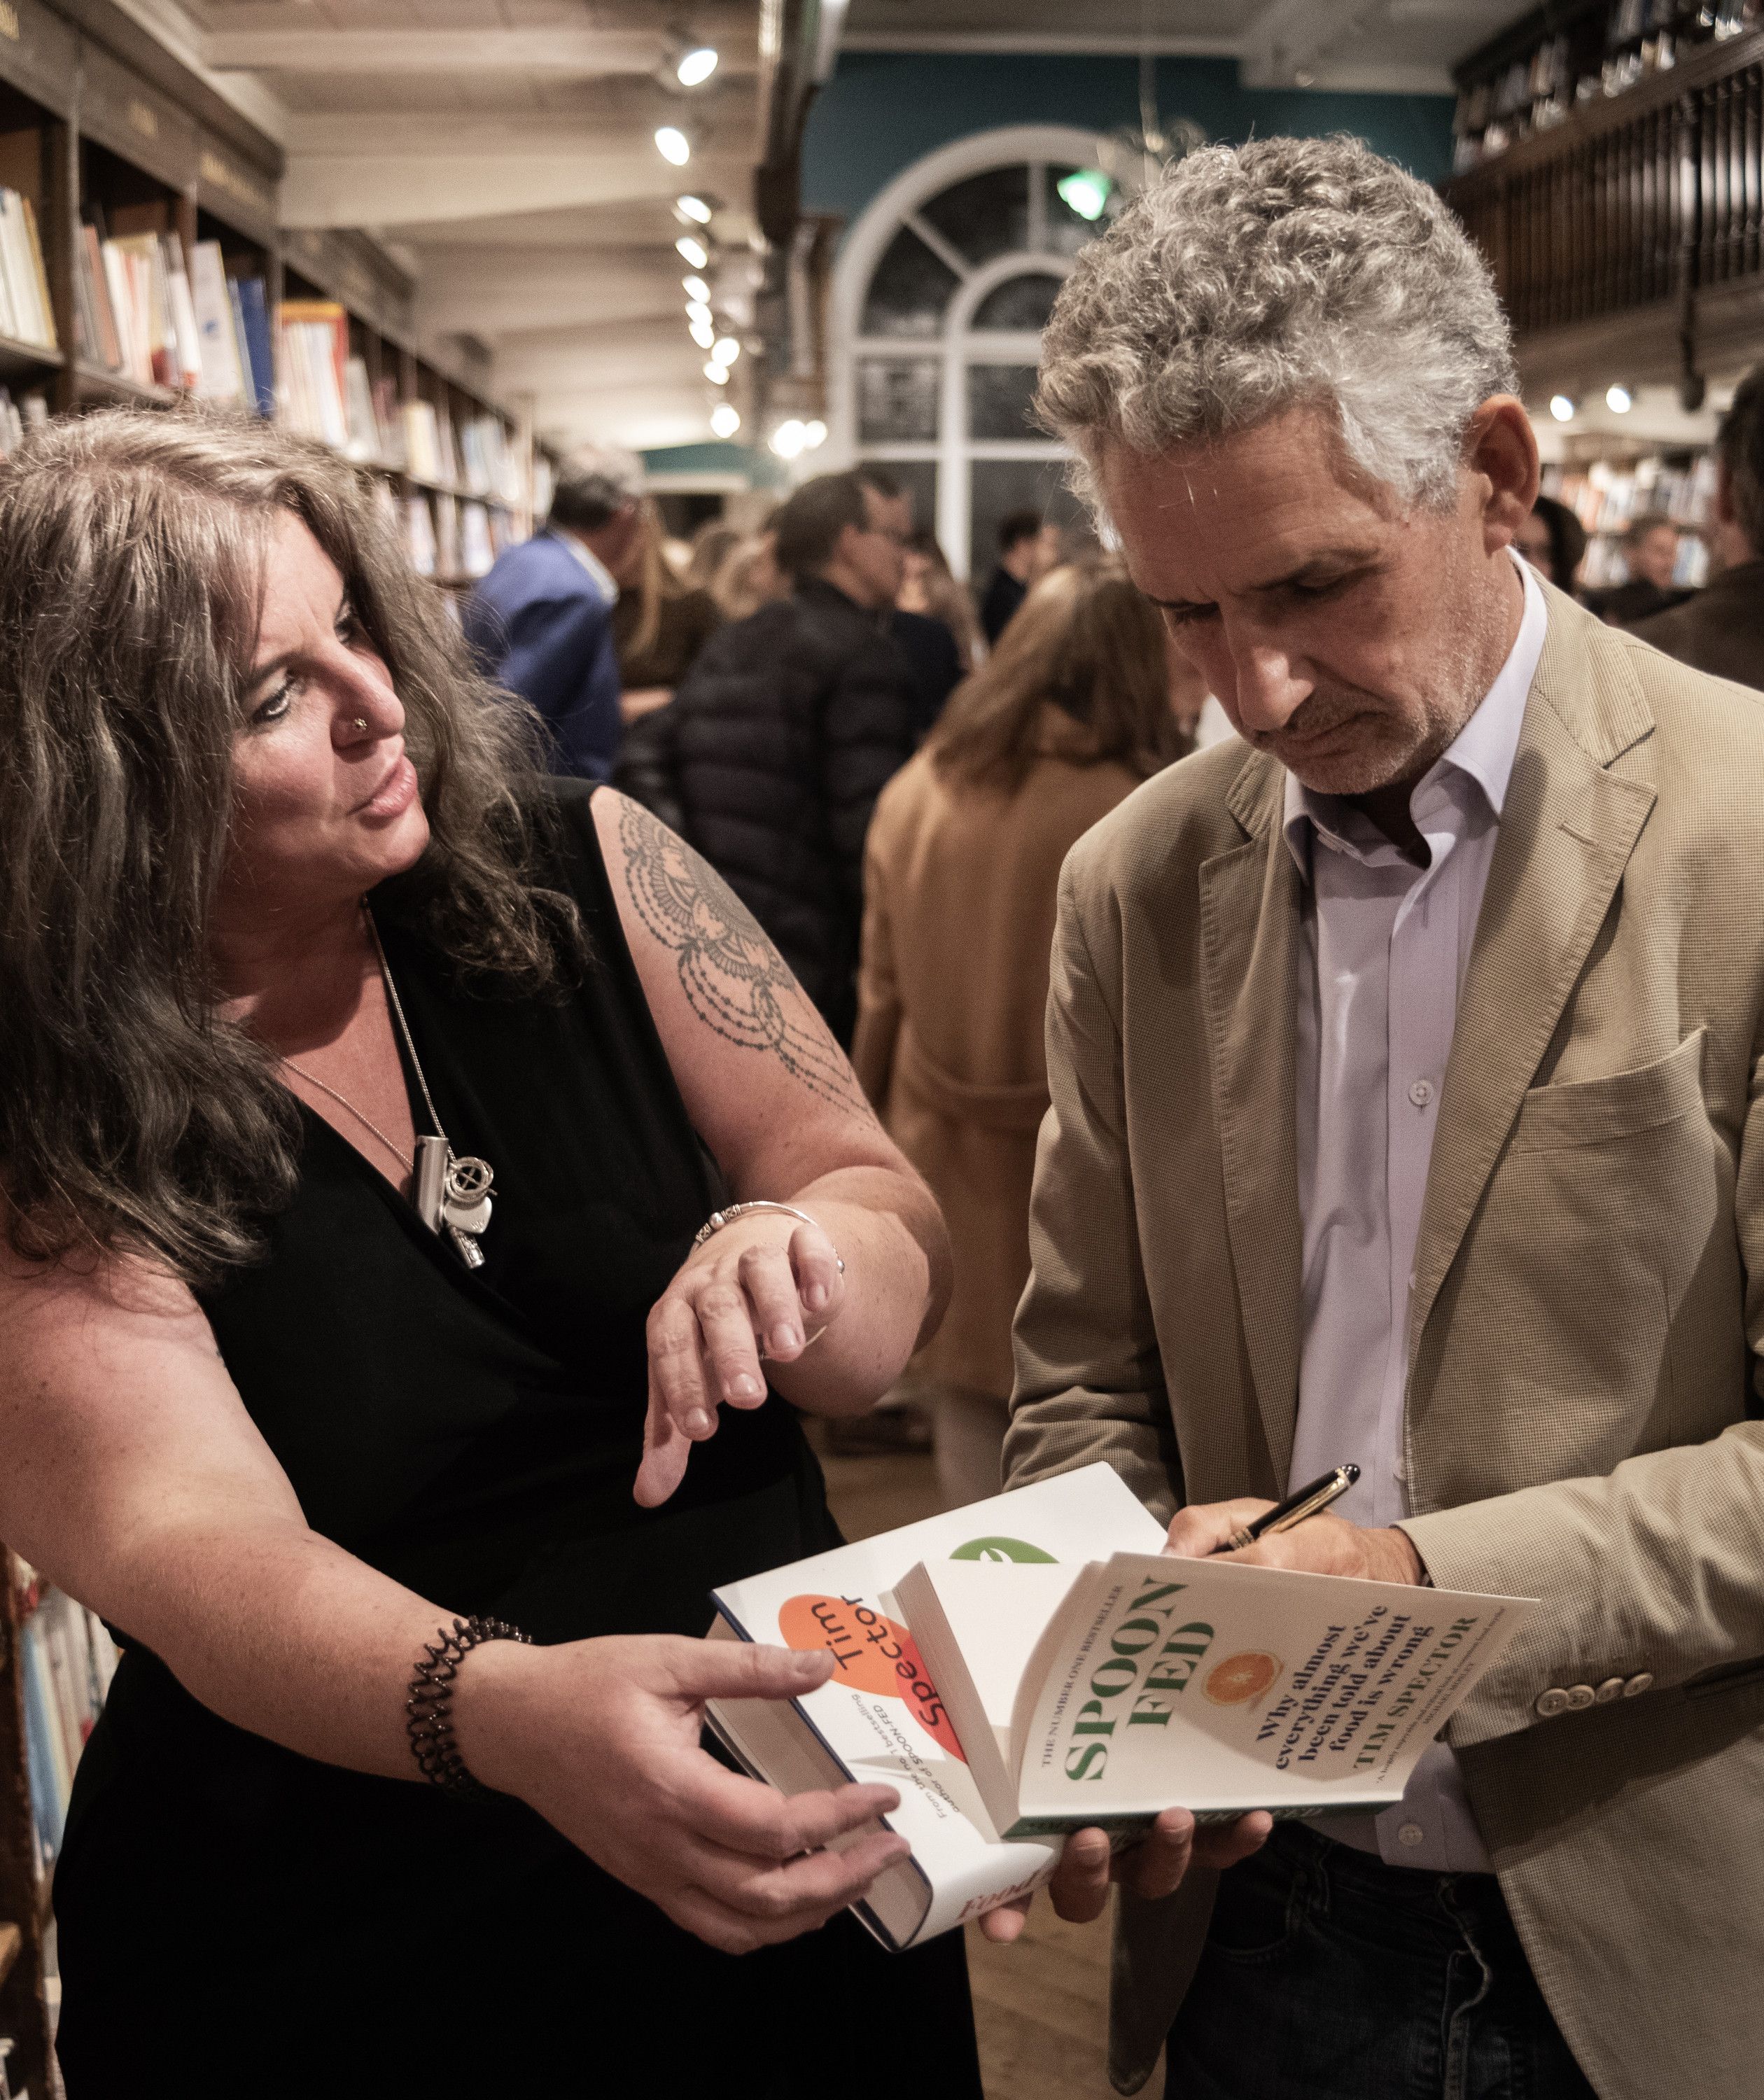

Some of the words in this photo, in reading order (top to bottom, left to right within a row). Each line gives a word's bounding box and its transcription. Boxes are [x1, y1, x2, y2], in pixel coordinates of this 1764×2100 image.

[811, 1602, 863, 1670] Tim
[841, 1595, 946, 1726] Spector
[1042, 1740, 1055, 1768] THE
[1049, 1681, 1074, 1736] NUMBER
[1069, 1655, 1086, 1679] ONE
[1080, 1585, 1123, 1653] BESTSELLER
[1064, 1576, 1189, 1780] SPOON
[1126, 1621, 1214, 1728] FED
[1256, 1694, 1298, 1741] Why
[1292, 1625, 1346, 1690] almost
[1275, 1664, 1352, 1770] everything
[1340, 1606, 1387, 1658] we've
[1298, 1714, 1340, 1760] been
[1332, 1673, 1368, 1708] told
[1364, 1616, 1411, 1669] about
[1329, 1711, 1368, 1750] food
[1357, 1690, 1383, 1705] is
[1378, 1626, 1434, 1685] wrong
[851, 1693, 893, 1748] bestselling
[874, 1704, 923, 1765] SPOON-FED
[1353, 1723, 1396, 1768] TIM
[1387, 1617, 1478, 1716] SPECTOR
[911, 1772, 925, 1791] the
[919, 1766, 932, 1777] of
[925, 1791, 947, 1819] From
[932, 1780, 960, 1813] author
